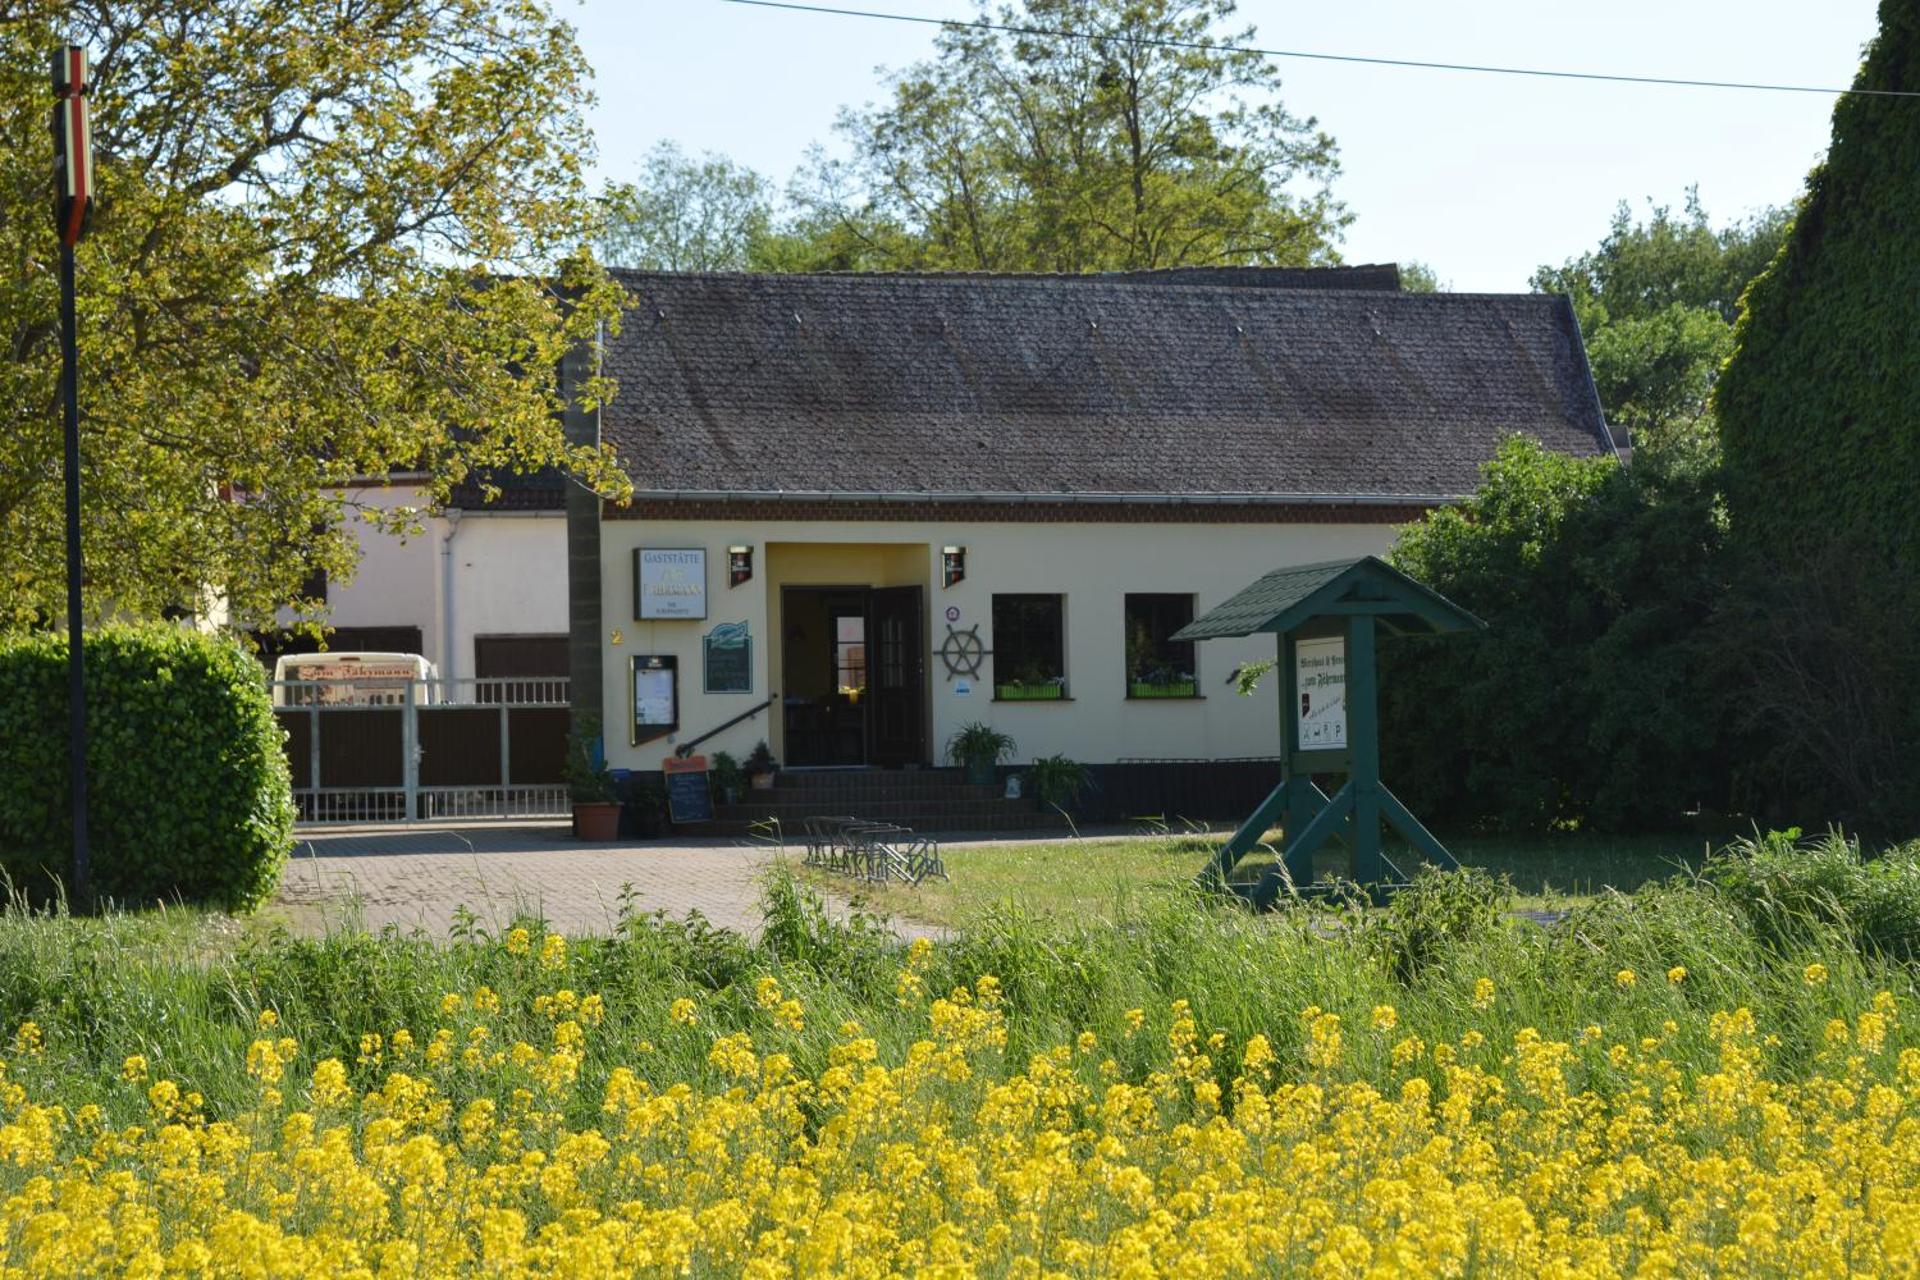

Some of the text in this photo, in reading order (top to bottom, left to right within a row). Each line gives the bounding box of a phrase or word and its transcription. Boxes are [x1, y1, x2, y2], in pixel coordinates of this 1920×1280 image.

[644, 552, 700, 564] GASTSTÄTTE
[611, 629, 624, 645] 2
[302, 665, 333, 678] Zum
